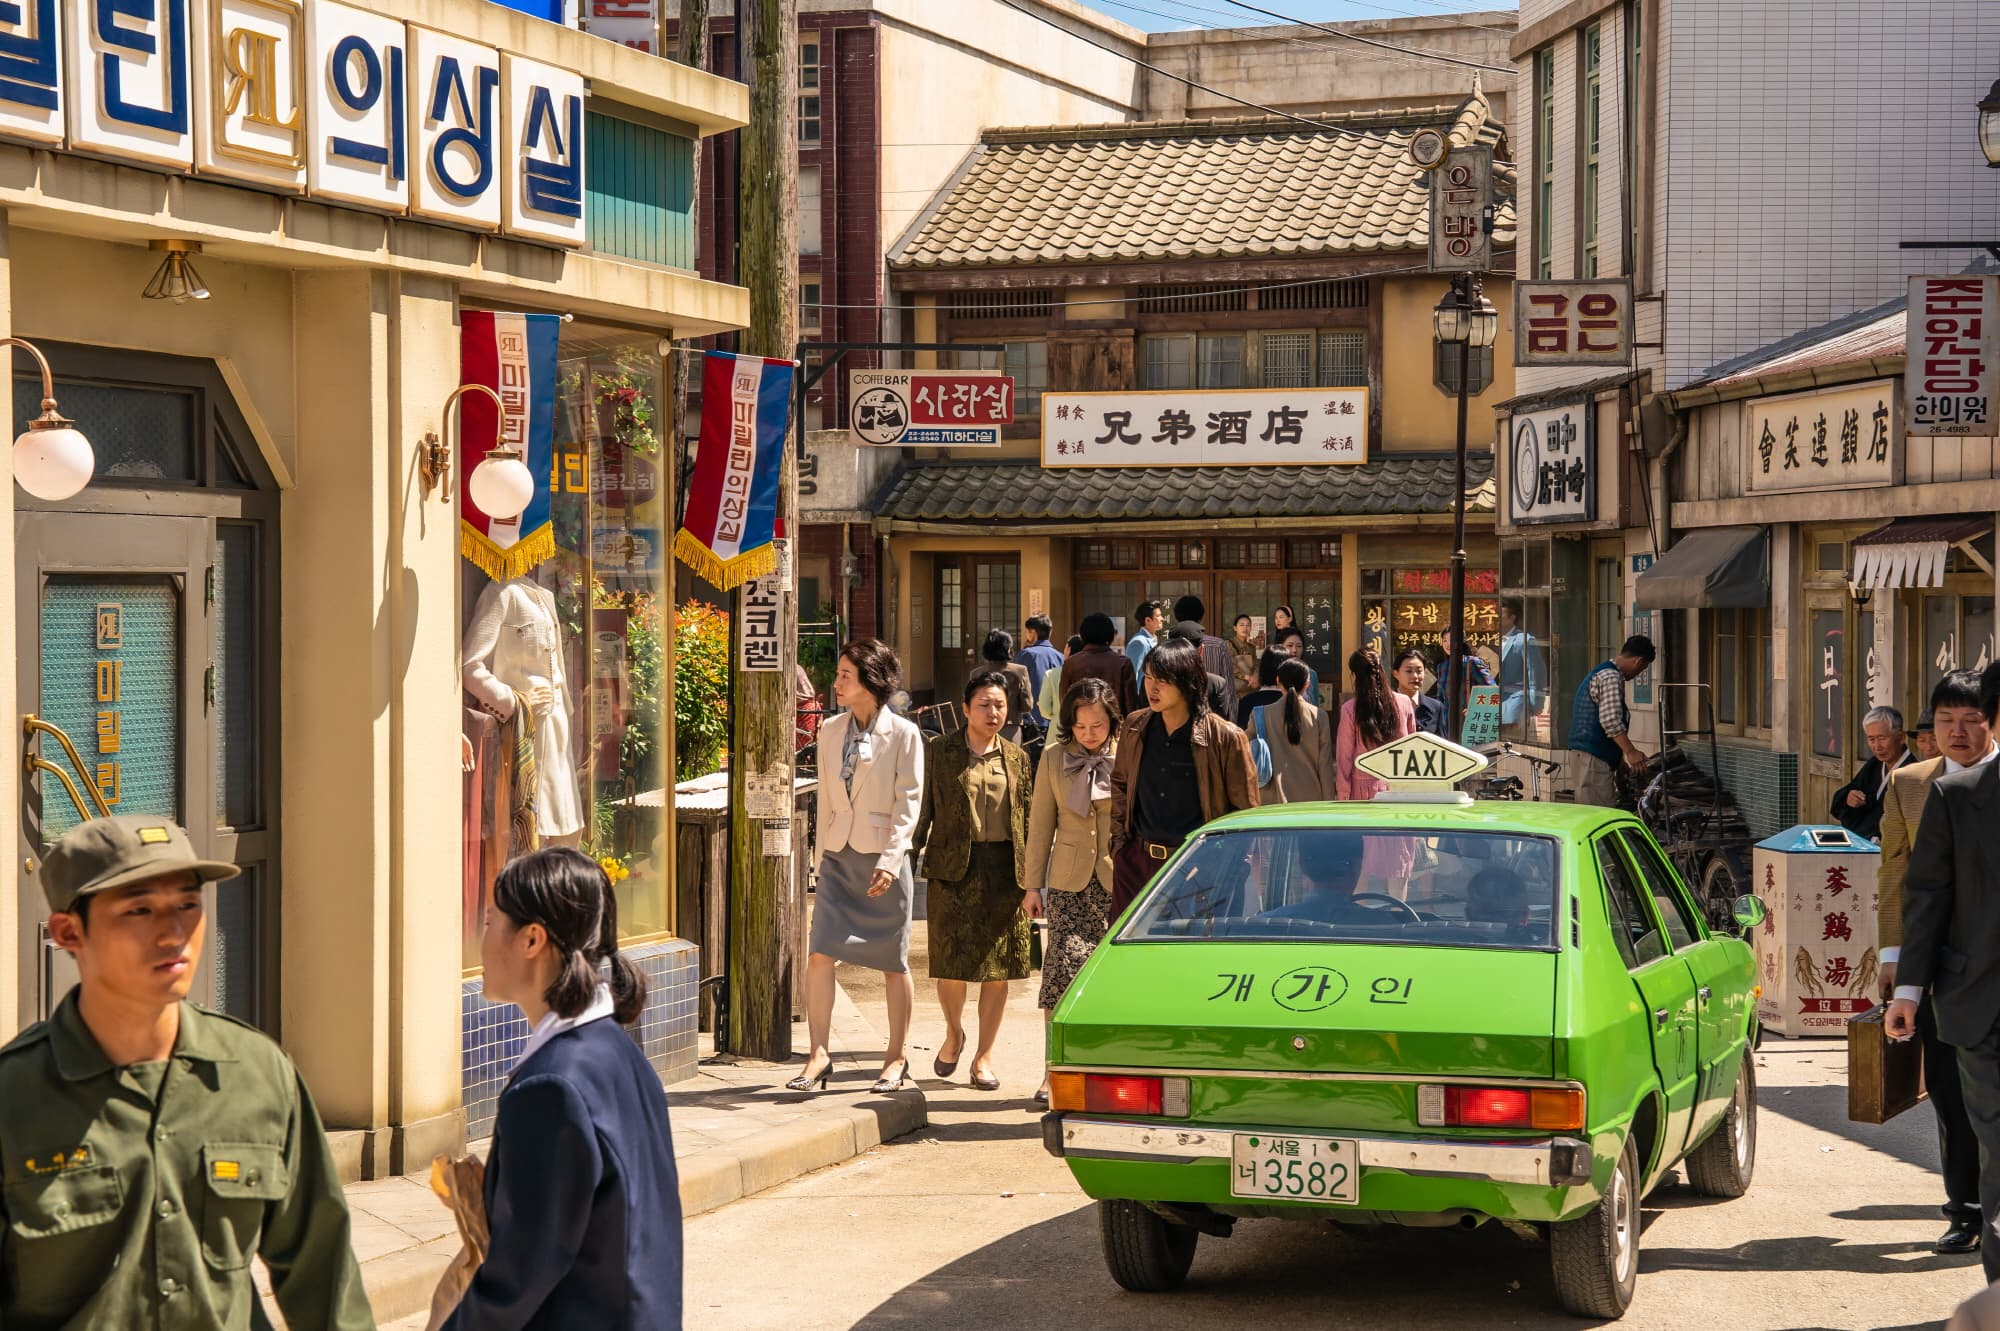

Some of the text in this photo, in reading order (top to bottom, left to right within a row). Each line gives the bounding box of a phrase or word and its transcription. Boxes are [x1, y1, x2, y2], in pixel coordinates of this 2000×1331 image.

[331, 34, 582, 219] 의상실
[1440, 165, 1478, 256] 은방
[1528, 293, 1618, 353] 금은
[1924, 279, 1986, 393] 준원당
[915, 383, 1010, 420] 사장실
[1914, 395, 1988, 424] 한의원
[1094, 405, 1309, 446] 兄弟酒店
[1400, 602, 1439, 626] 국밥
[1463, 603, 1499, 626] 탁주
[1388, 749, 1447, 777] TAXI
[1268, 1139, 1318, 1157] 서울 1
[1238, 1158, 1348, 1198] 너 3582
